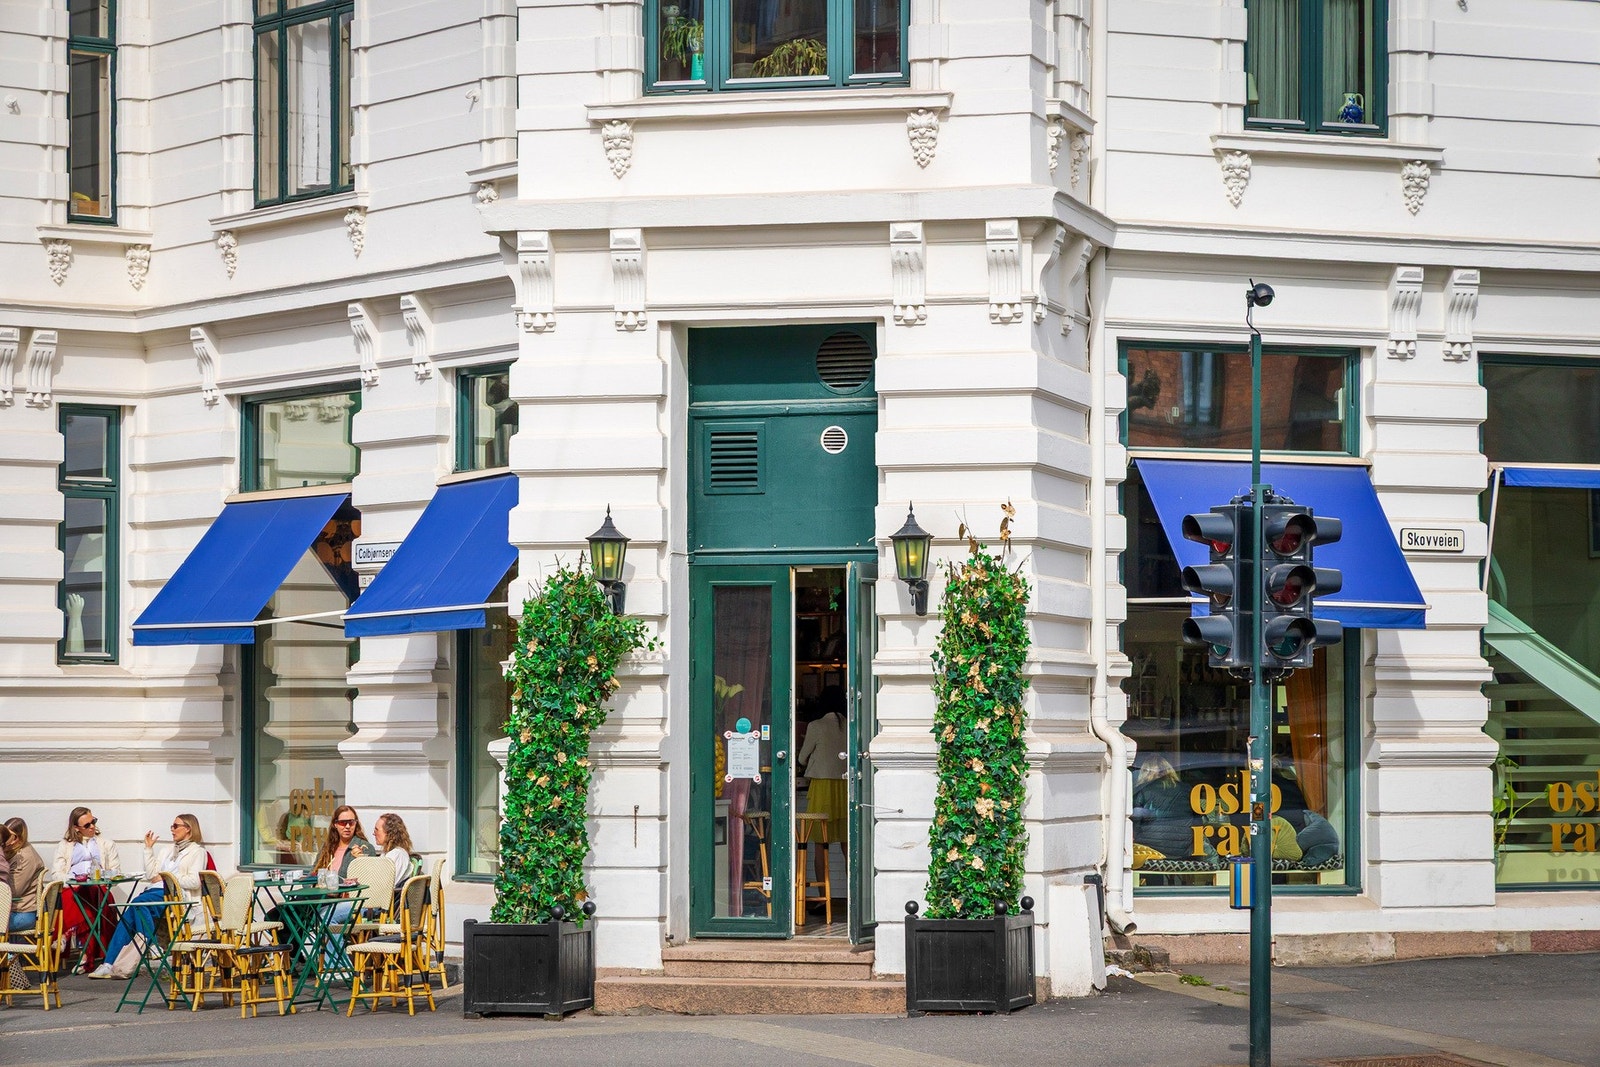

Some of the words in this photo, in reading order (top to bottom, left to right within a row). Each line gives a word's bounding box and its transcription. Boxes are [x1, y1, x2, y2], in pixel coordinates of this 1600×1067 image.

[1407, 532, 1459, 547] Skovveien
[289, 777, 334, 818] oslo
[1548, 769, 1600, 813] os
[1550, 822, 1600, 853] ra
